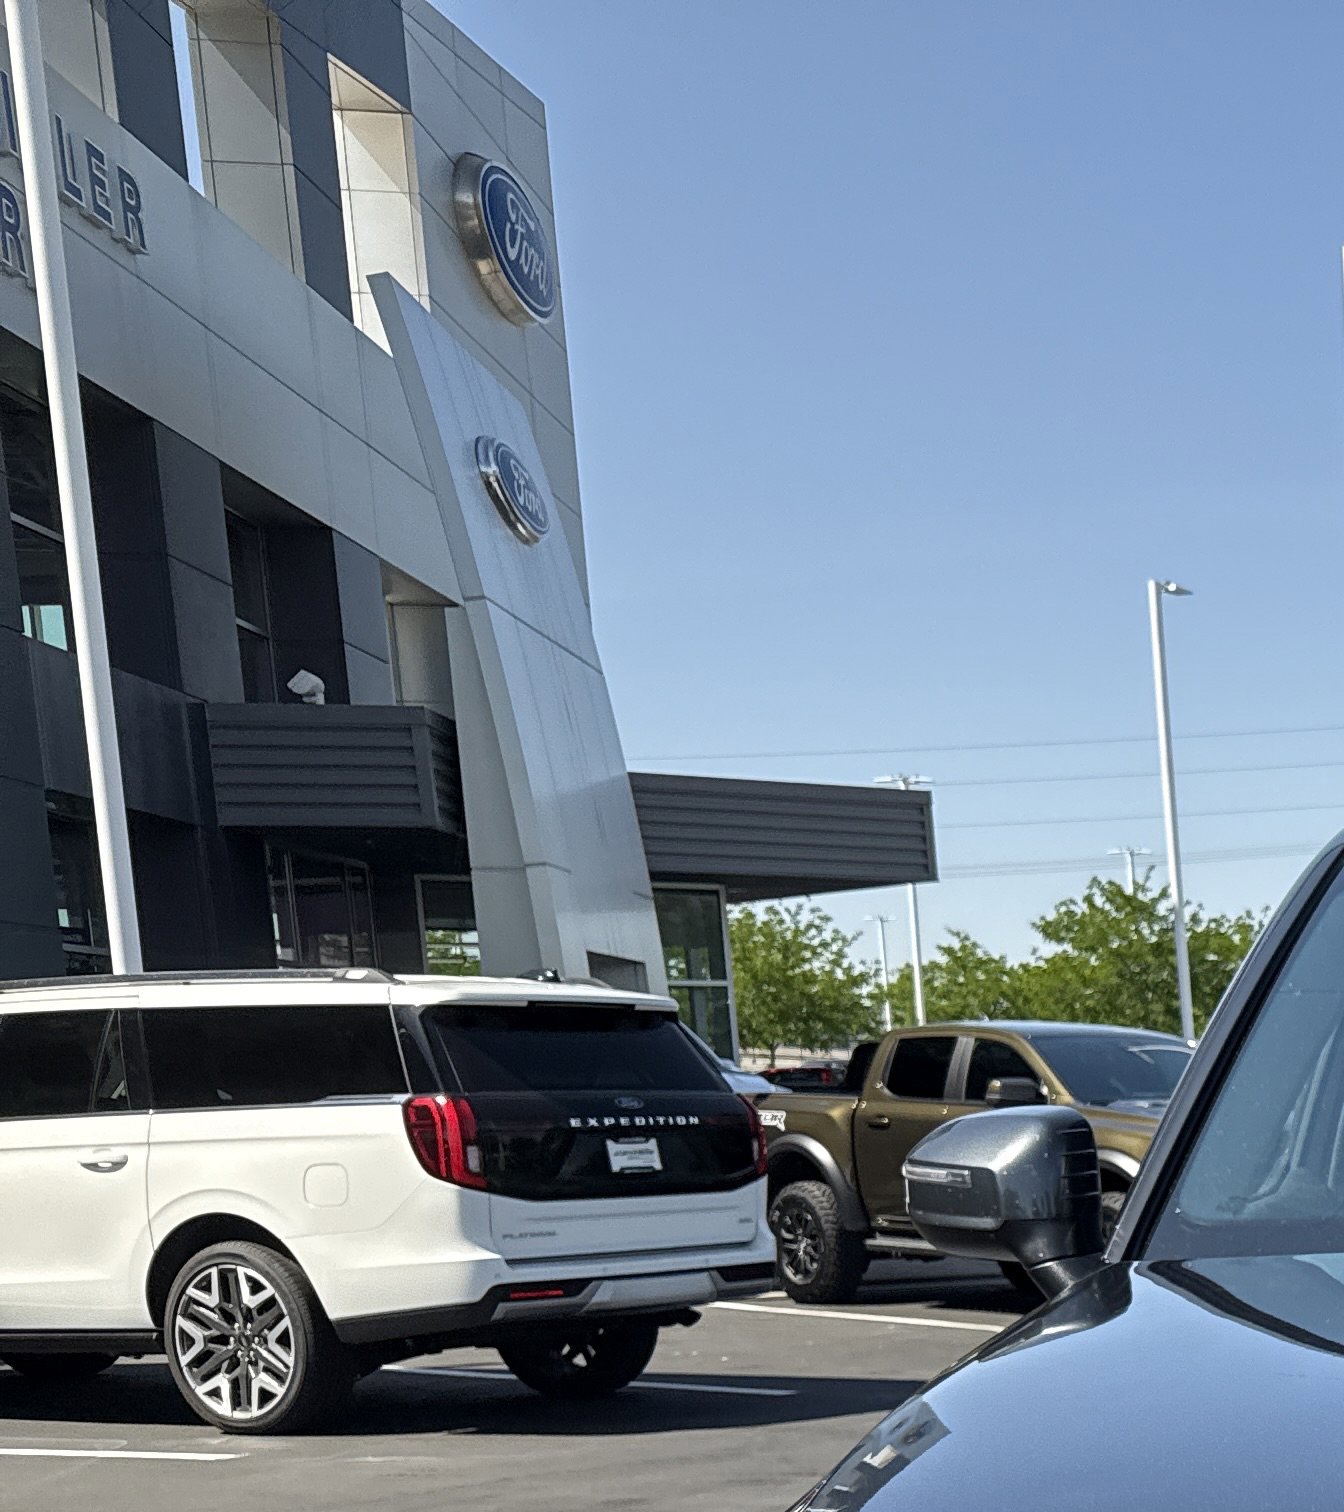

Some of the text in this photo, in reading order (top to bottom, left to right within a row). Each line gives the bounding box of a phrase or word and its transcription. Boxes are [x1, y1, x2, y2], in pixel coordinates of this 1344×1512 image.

[504, 191, 548, 298] Ford
[510, 458, 545, 522] Ford
[569, 1115, 699, 1128] EXPEDITION
